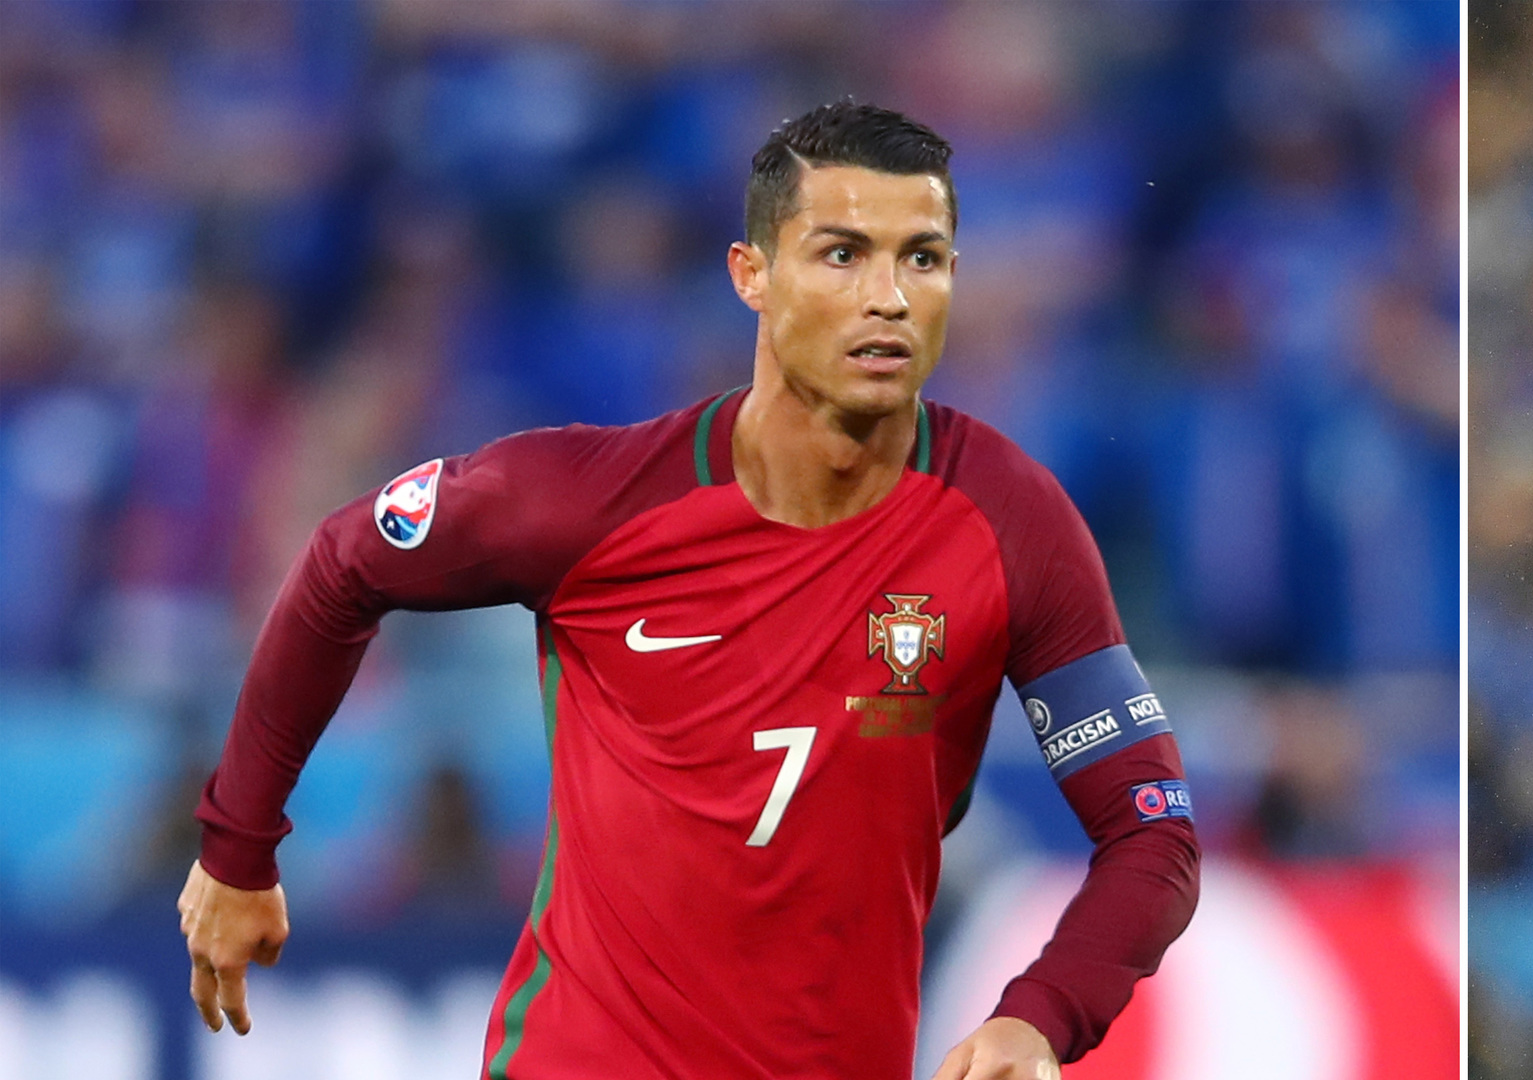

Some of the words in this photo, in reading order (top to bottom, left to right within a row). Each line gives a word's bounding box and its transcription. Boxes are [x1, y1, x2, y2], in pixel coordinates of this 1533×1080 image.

[1048, 715, 1119, 760] RACISM
[745, 726, 817, 848] 7
[1165, 788, 1188, 808] RE
